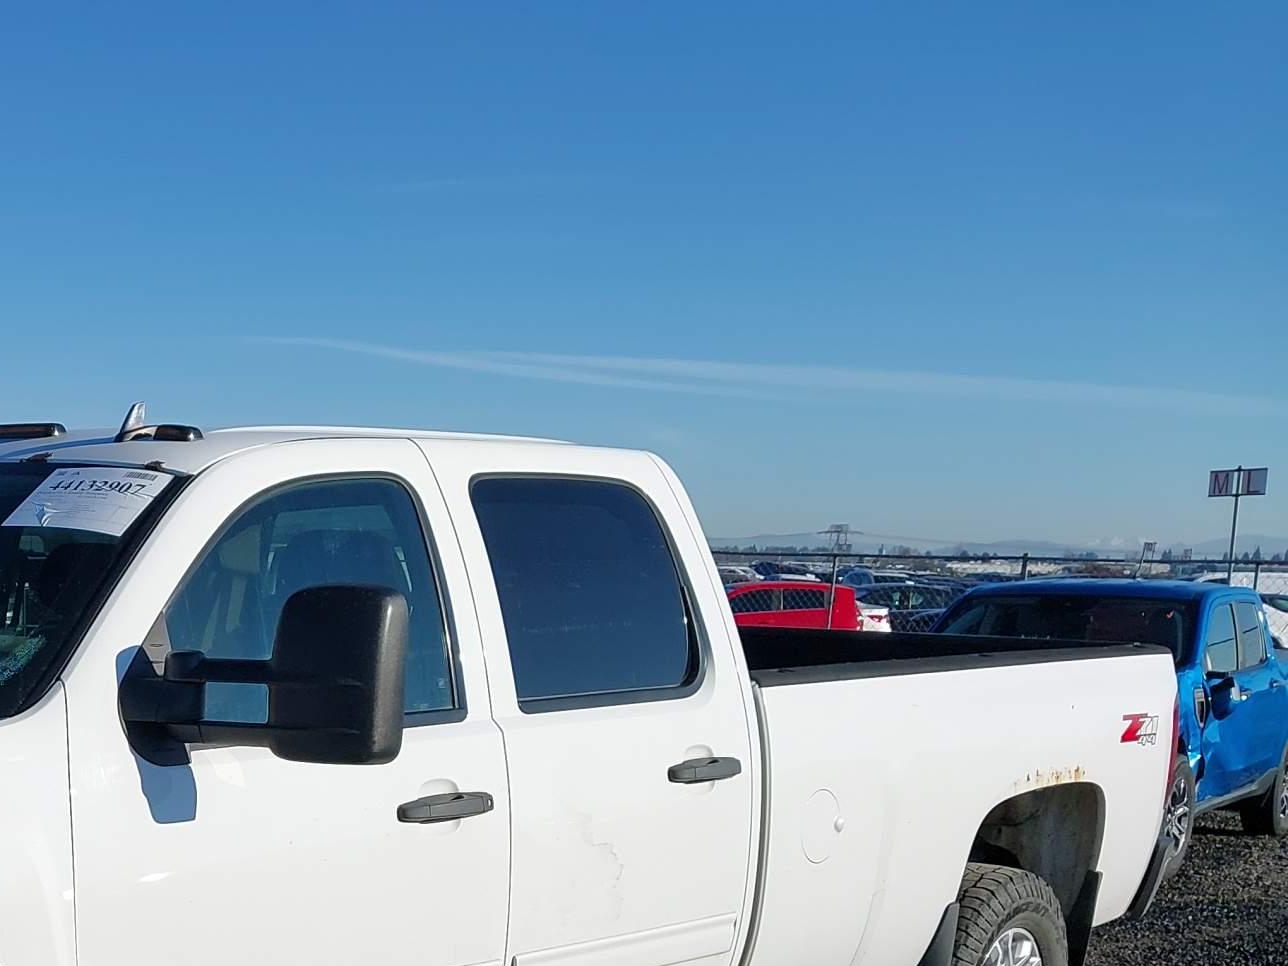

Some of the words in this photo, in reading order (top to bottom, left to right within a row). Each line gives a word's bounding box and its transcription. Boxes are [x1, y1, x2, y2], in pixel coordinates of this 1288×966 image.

[48, 479, 148, 496] 44132907
[1213, 472, 1230, 495] M
[1246, 471, 1262, 494] L
[1120, 713, 1160, 743] Z71
